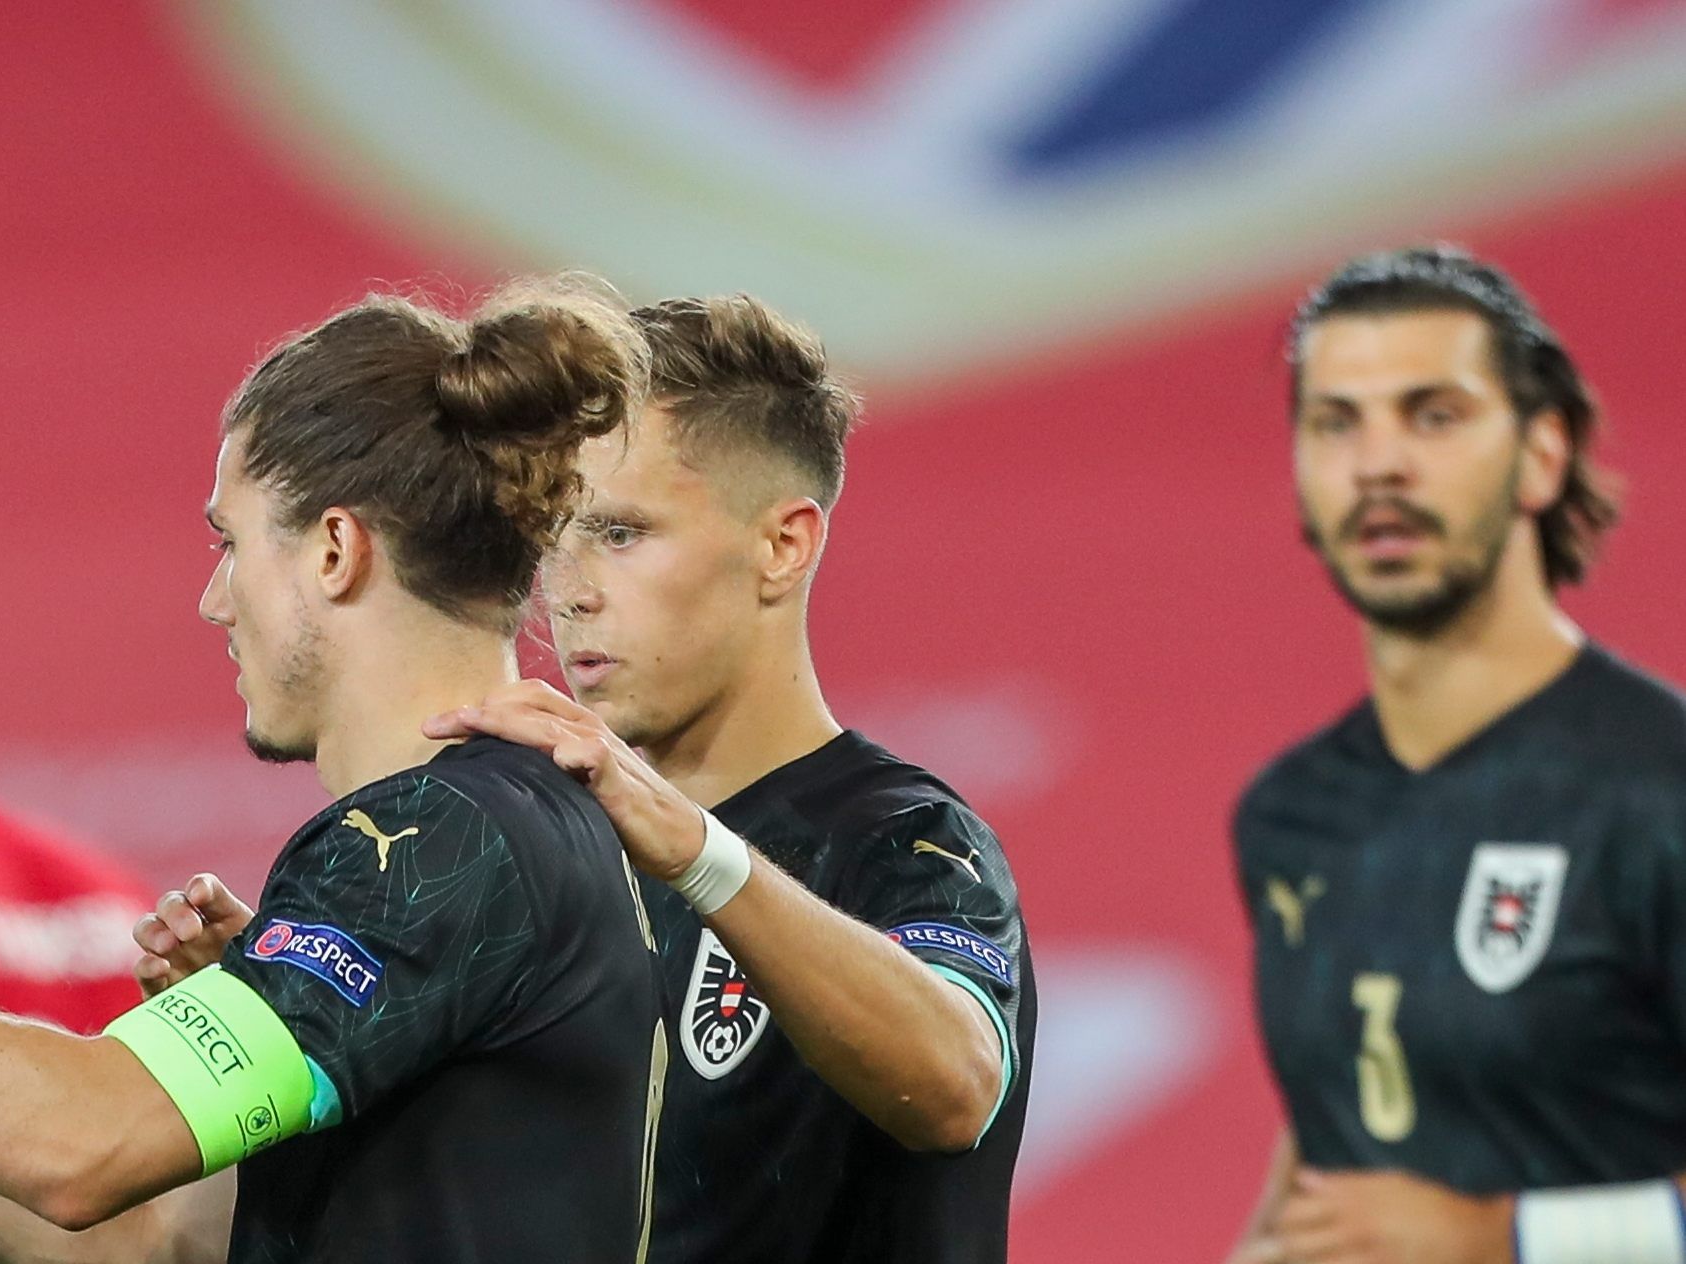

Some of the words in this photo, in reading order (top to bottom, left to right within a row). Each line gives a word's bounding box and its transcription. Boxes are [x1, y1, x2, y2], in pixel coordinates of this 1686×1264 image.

[284, 934, 377, 993] RESPECT
[905, 928, 1010, 974] RESPECT
[154, 994, 245, 1075] RESPECT
[1352, 973, 1416, 1141] 3
